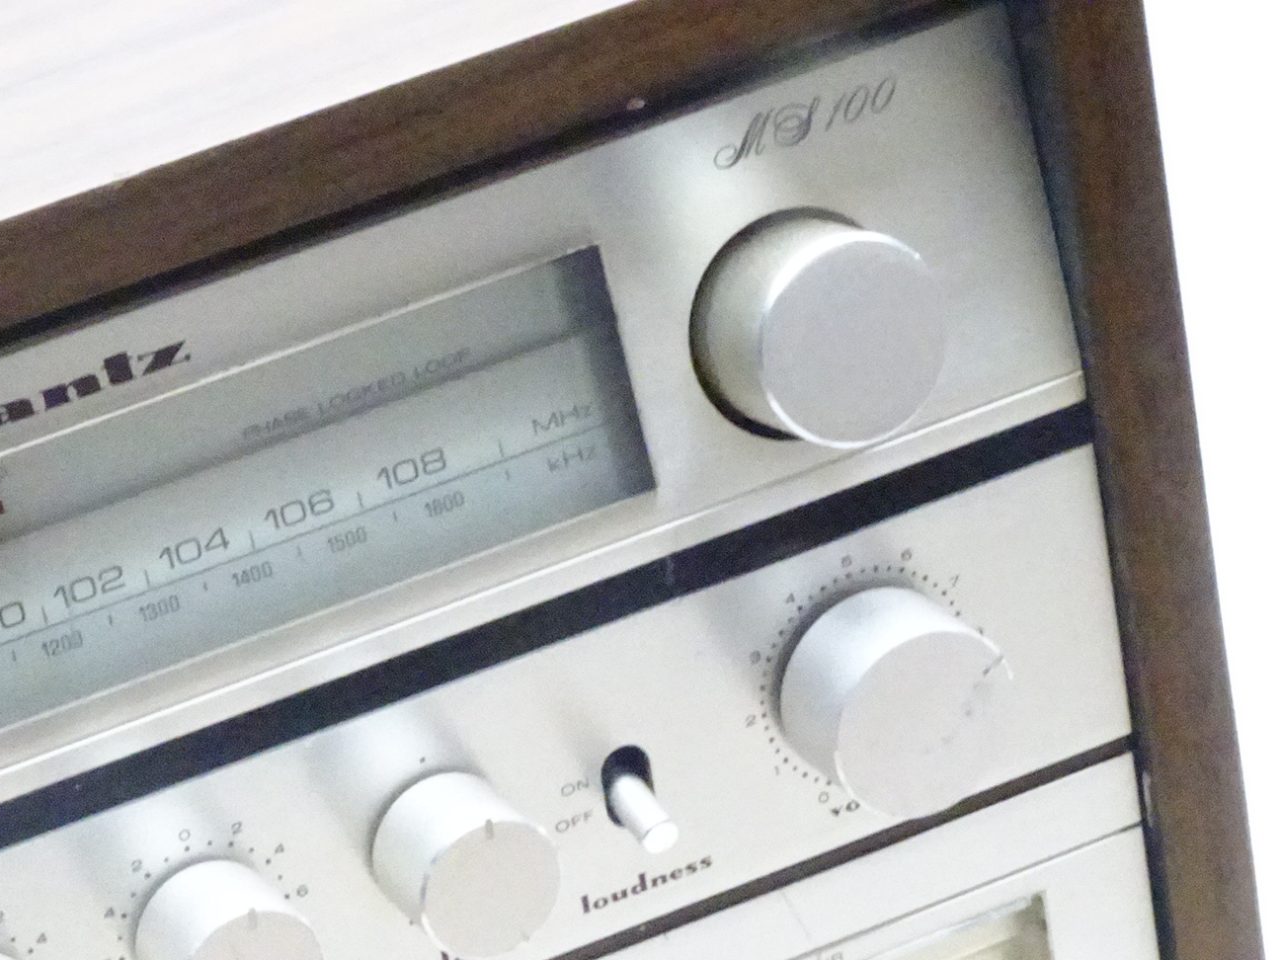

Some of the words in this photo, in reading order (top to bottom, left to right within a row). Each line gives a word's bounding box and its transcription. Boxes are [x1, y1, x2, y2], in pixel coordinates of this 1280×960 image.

[53, 565, 124, 608] 102
[159, 526, 231, 571] 104
[265, 488, 336, 531] 106
[376, 446, 448, 490] 108
[531, 402, 593, 436] MHz
[41, 630, 83, 658] 1200
[138, 594, 180, 622] 1300
[232, 560, 273, 588] 1400
[327, 526, 368, 553] 1500
[424, 490, 465, 518] 1600
[546, 443, 597, 473] kHz
[560, 776, 589, 798] ON
[555, 809, 595, 834] OFF
[580, 854, 714, 915] loudness
